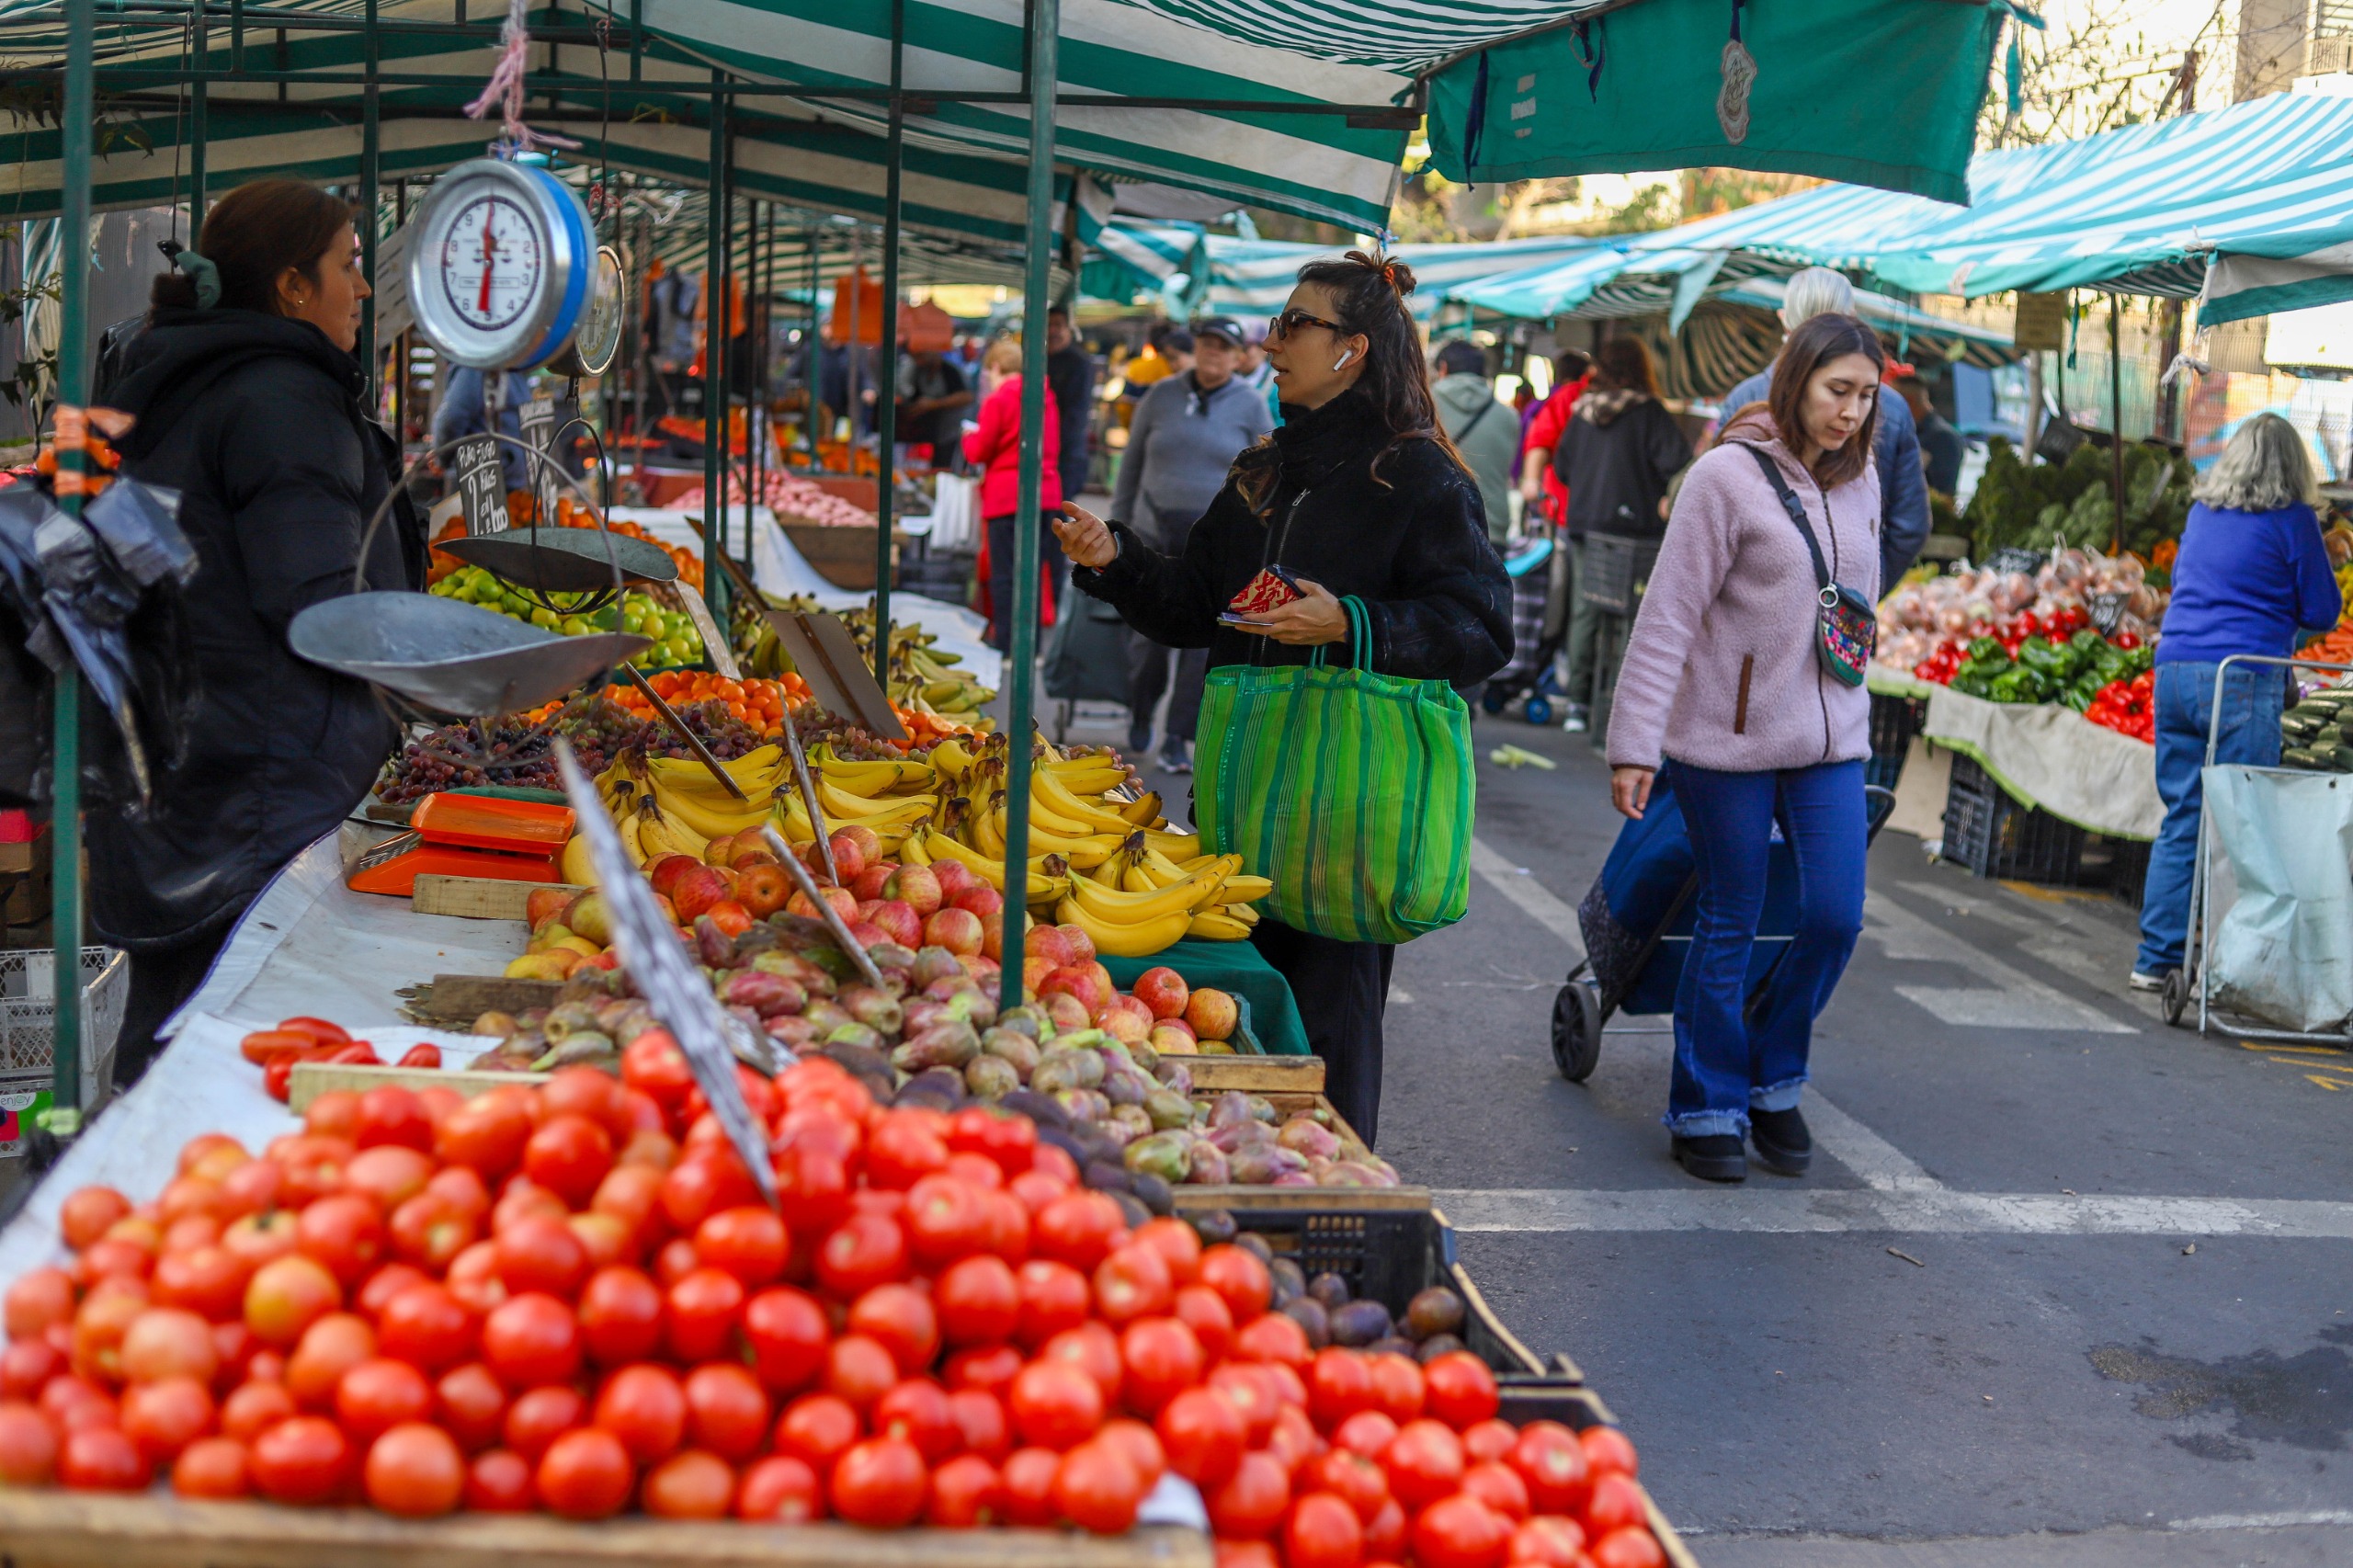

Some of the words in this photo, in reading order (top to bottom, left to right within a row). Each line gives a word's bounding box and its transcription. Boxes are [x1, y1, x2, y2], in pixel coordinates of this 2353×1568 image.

[465, 213, 472, 226] 9
[511, 214, 517, 226] 1
[450, 240, 458, 253] 8
[523, 240, 531, 254] 2
[449, 271, 457, 284] 7
[522, 273, 529, 286] 3
[462, 298, 470, 311] 6
[506, 300, 514, 312] 4
[1, 1095, 31, 1106] enjoy
